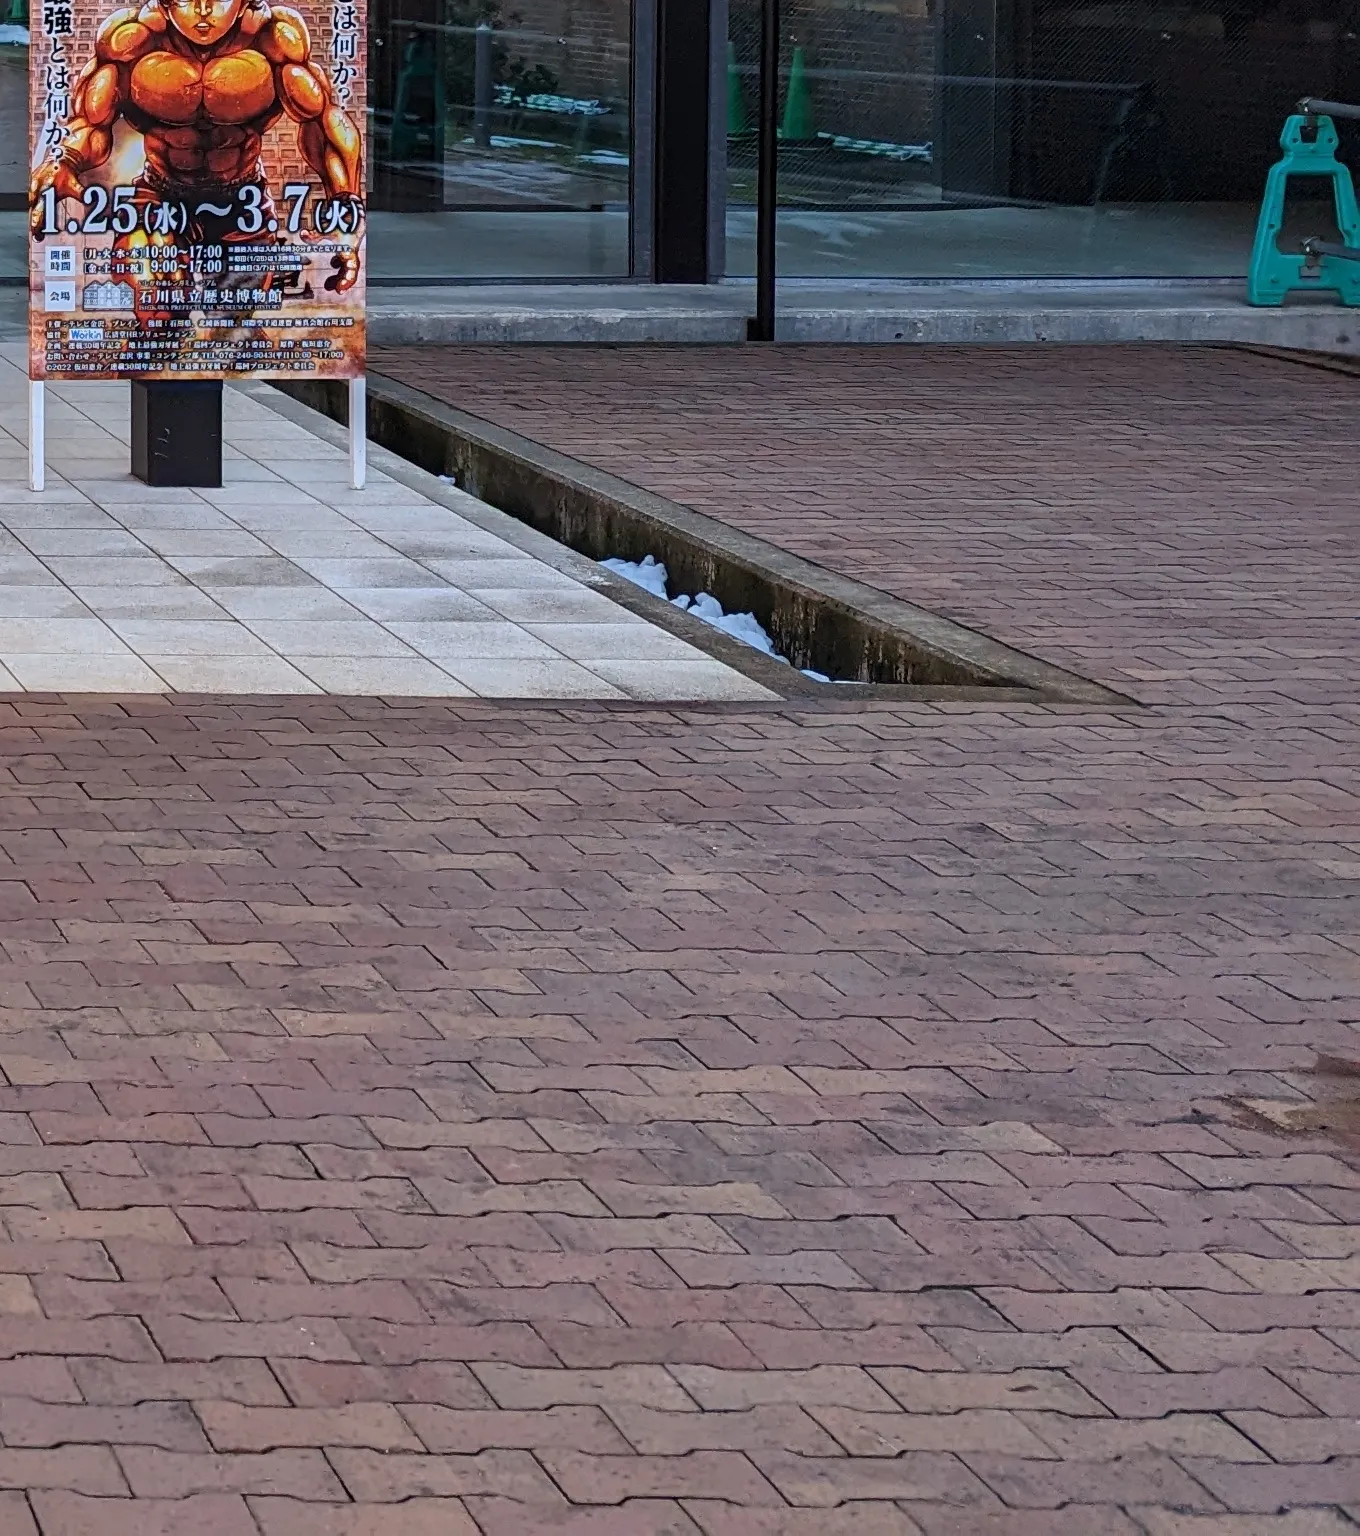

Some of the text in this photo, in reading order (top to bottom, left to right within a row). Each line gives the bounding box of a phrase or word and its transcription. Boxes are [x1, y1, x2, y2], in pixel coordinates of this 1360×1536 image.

[50, 261, 71, 272] 時間
[50, 291, 71, 302] 会場
[139, 289, 283, 304] 石川県立歴史博物館
